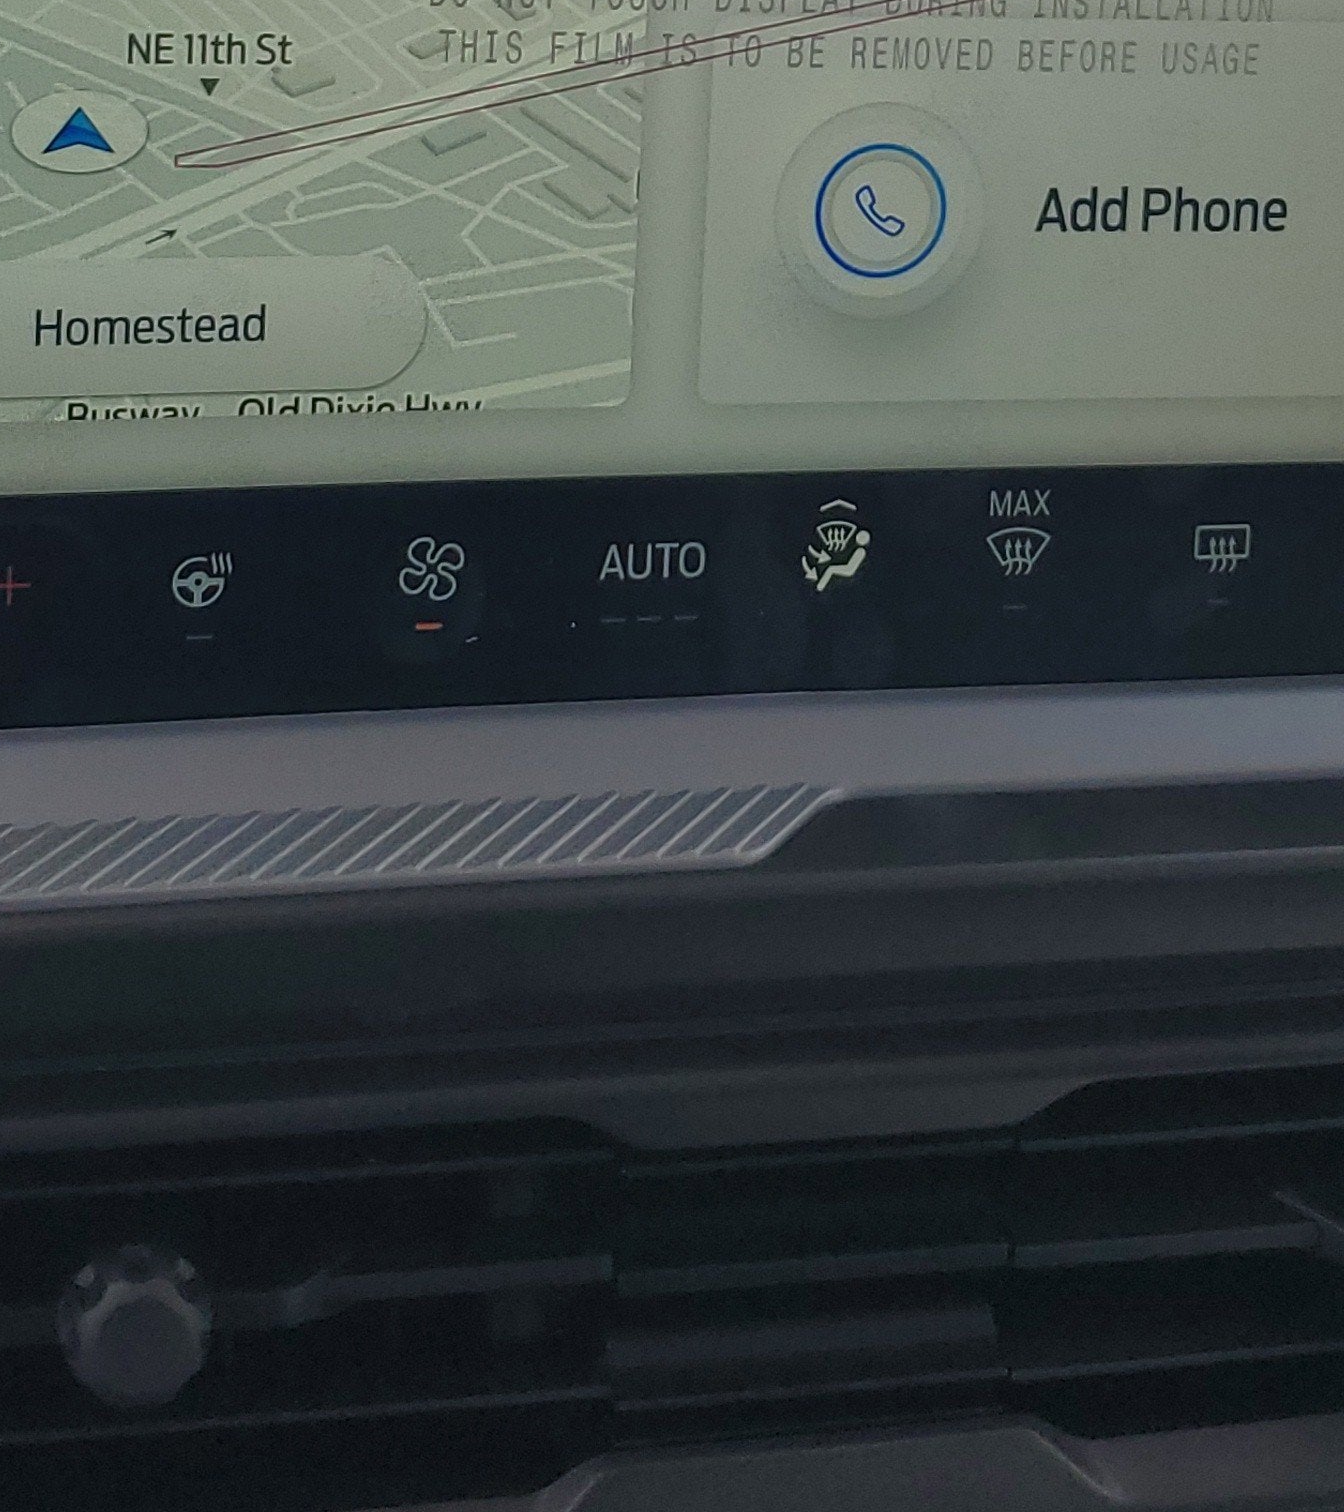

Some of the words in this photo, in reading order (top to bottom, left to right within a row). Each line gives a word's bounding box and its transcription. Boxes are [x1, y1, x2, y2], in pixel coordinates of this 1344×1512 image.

[127, 35, 174, 66] NE
[183, 35, 246, 65] 11th
[255, 35, 293, 65] St
[439, 29, 523, 64] THIS
[550, 31, 634, 66] FILM
[662, 32, 698, 65] IS
[727, 35, 762, 68] TO
[787, 35, 825, 69] BE
[851, 36, 993, 71] REMOVED
[1018, 39, 1137, 74] BEFORE
[1162, 42, 1259, 76] USAGE
[1035, 186, 1128, 232] Add
[1142, 188, 1289, 232] Phone
[34, 304, 267, 346] Homestead
[989, 490, 1052, 517] MAX
[599, 540, 706, 581] AUTO
